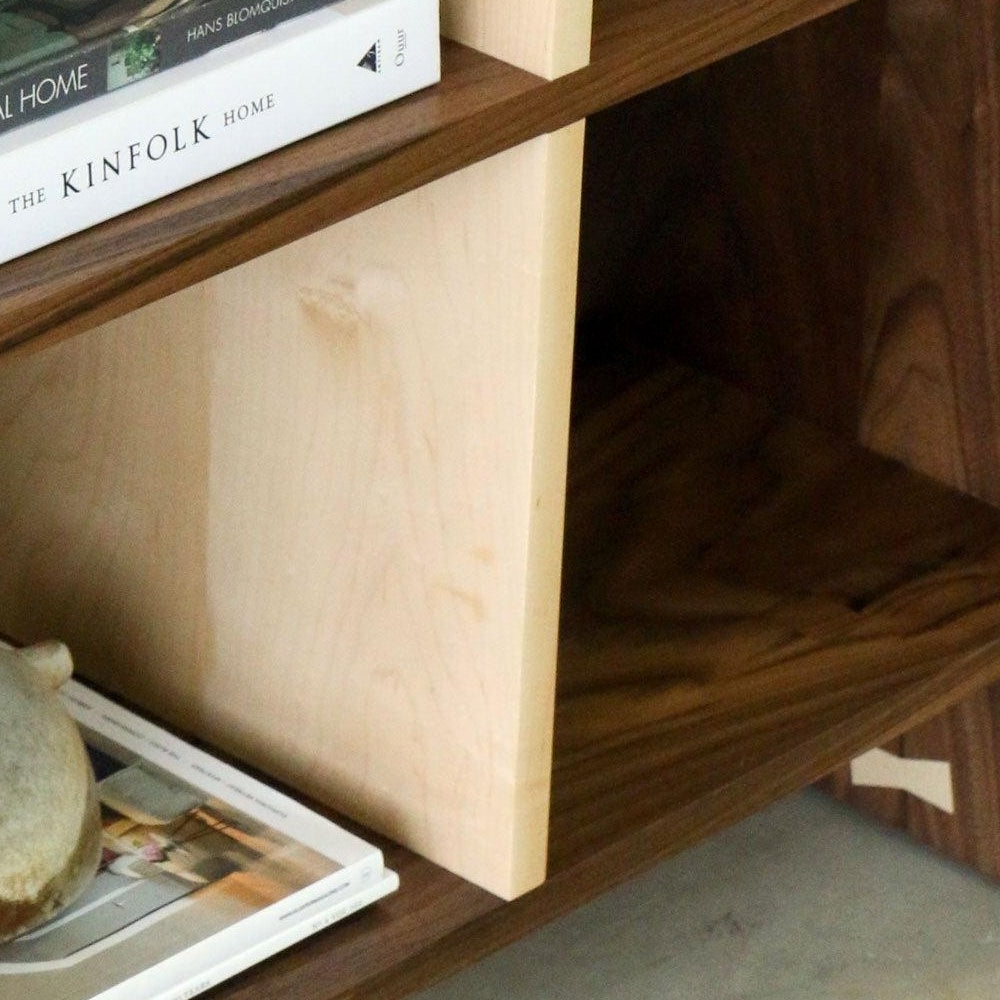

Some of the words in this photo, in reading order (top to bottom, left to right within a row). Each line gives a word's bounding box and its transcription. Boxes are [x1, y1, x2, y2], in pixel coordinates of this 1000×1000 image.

[187, 17, 223, 42] HANS
[20, 63, 88, 113] HOME
[8, 187, 46, 214] THE
[60, 115, 211, 199] KINFOLK
[223, 93, 276, 128] HOME
